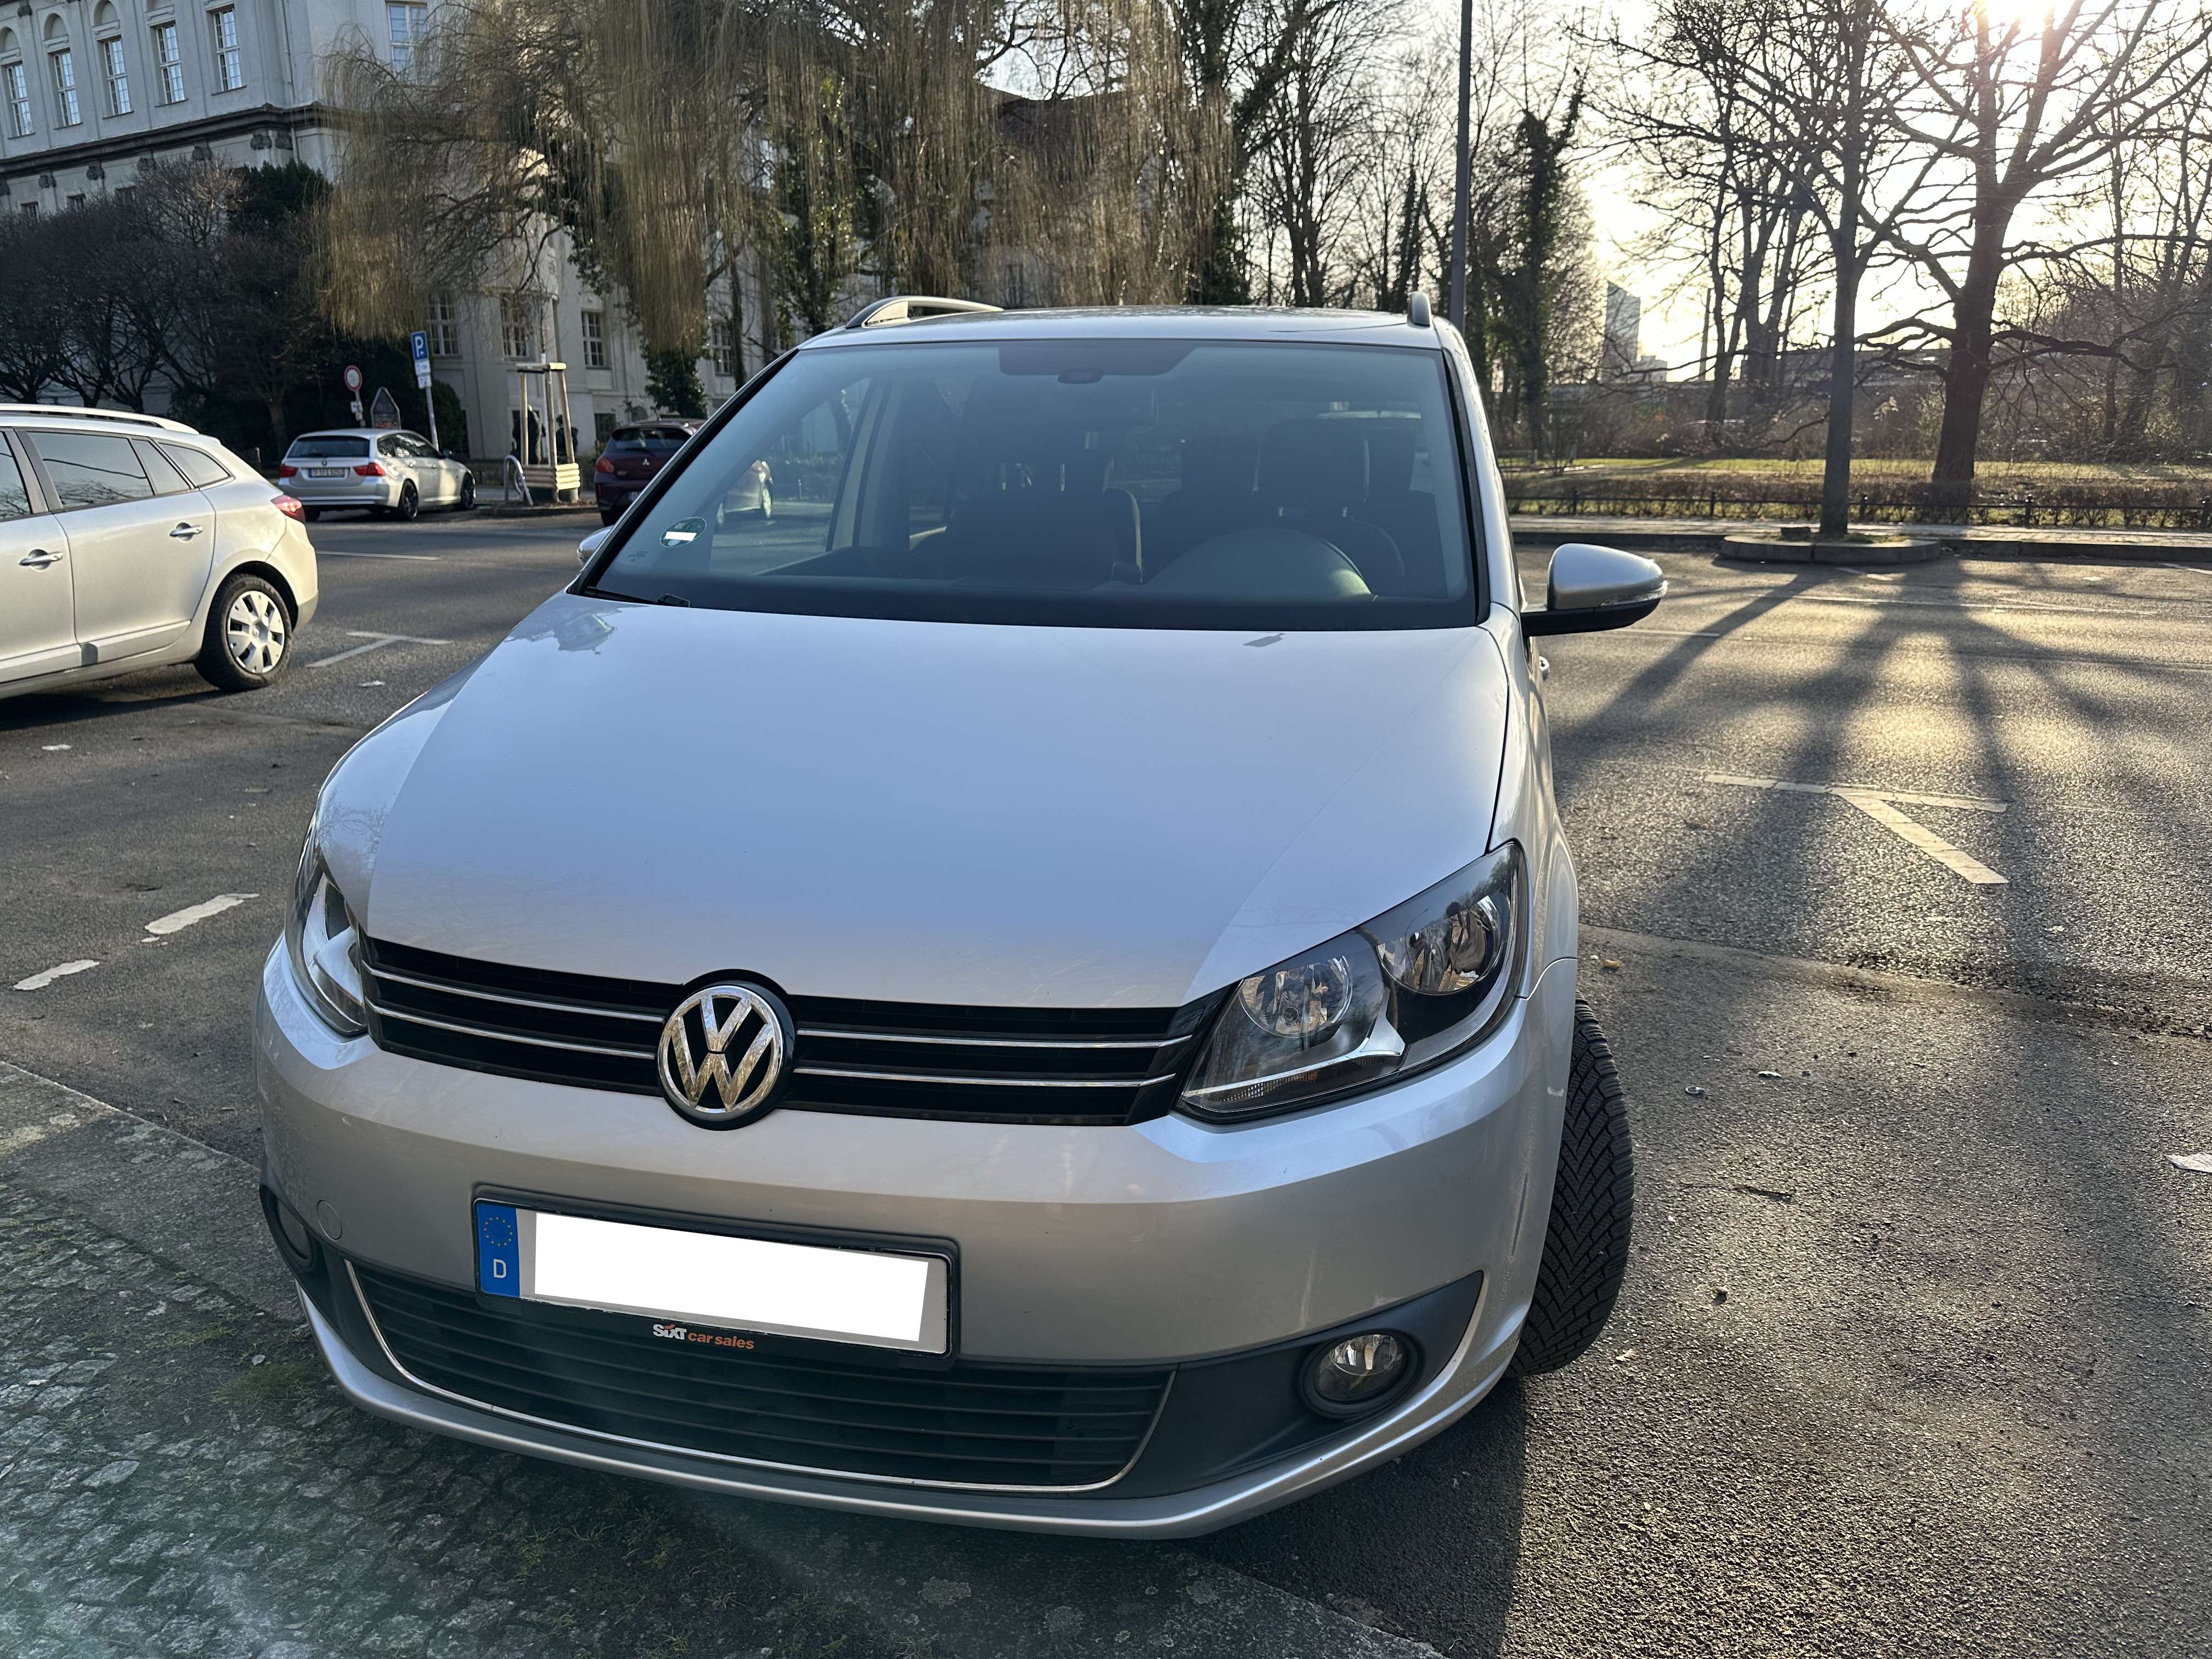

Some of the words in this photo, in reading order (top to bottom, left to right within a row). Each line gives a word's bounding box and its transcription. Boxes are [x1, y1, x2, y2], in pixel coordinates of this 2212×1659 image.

[415, 336, 424, 358] P
[665, 991, 777, 1113] VW
[493, 1259, 507, 1279] D
[688, 1333, 713, 1344] car
[715, 1336, 755, 1350] sales
